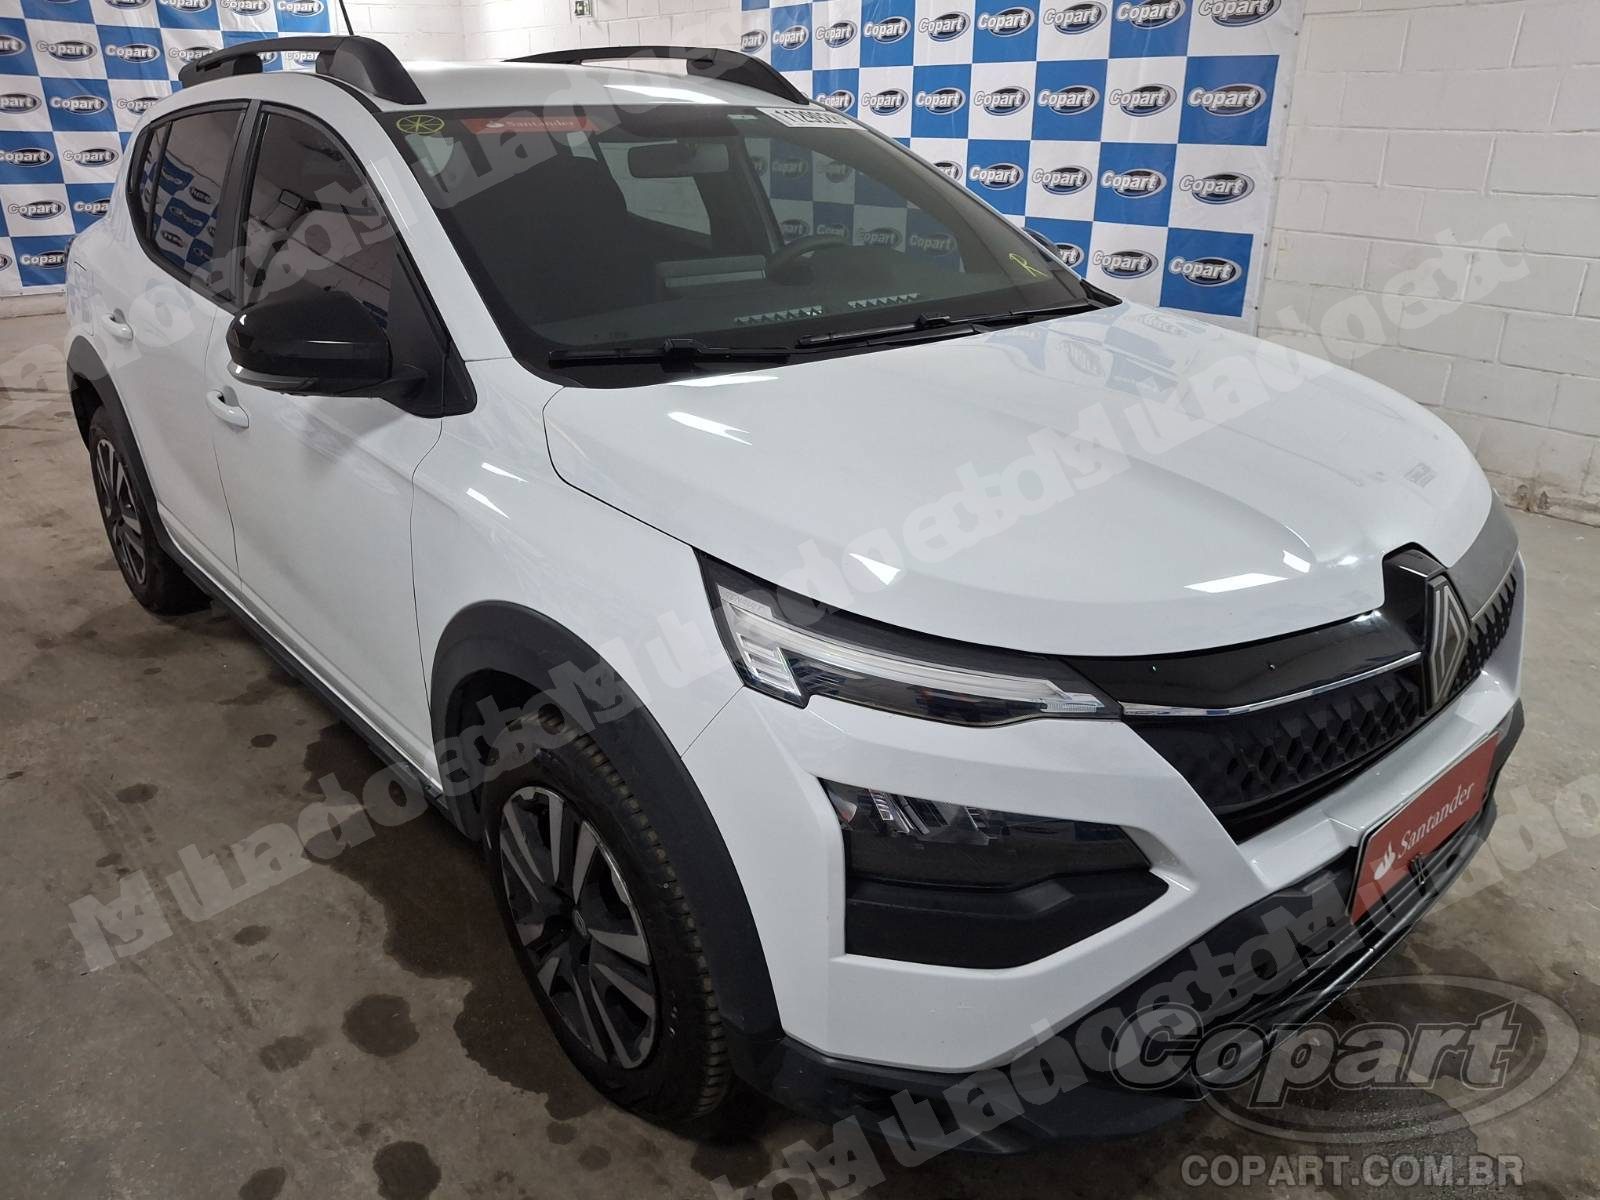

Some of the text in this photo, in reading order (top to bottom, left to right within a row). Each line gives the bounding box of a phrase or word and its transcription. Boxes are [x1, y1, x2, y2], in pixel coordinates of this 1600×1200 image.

[277, 1, 319, 12] Copart
[1117, 2, 1176, 24] Copart
[1200, 0, 1267, 20] Copart
[919, 18, 964, 35] Copart
[978, 13, 1027, 31] Copart
[1044, 8, 1099, 28] Copart
[772, 30, 804, 46] Copart
[816, 26, 852, 42] Copart
[864, 23, 905, 39] Copart
[37, 40, 89, 56] Copart
[105, 44, 153, 58] Copart
[285, 51, 319, 61] Copar
[50, 96, 102, 111] Copart
[861, 92, 903, 110] Copart
[915, 91, 960, 110] Copart
[974, 91, 1022, 109] Copart
[1038, 90, 1093, 108] Copart
[1109, 89, 1168, 110] Copart
[1188, 87, 1259, 111] Copart
[63, 150, 112, 164] Copart
[969, 164, 1017, 185] Copart
[1032, 168, 1083, 188] Copart
[1101, 169, 1157, 192] Copart
[1179, 175, 1245, 198] Copart
[8, 203, 58, 215] Copart
[1093, 251, 1148, 272] Copart
[1170, 256, 1232, 280] Copart
[1398, 782, 1475, 857] Santander
